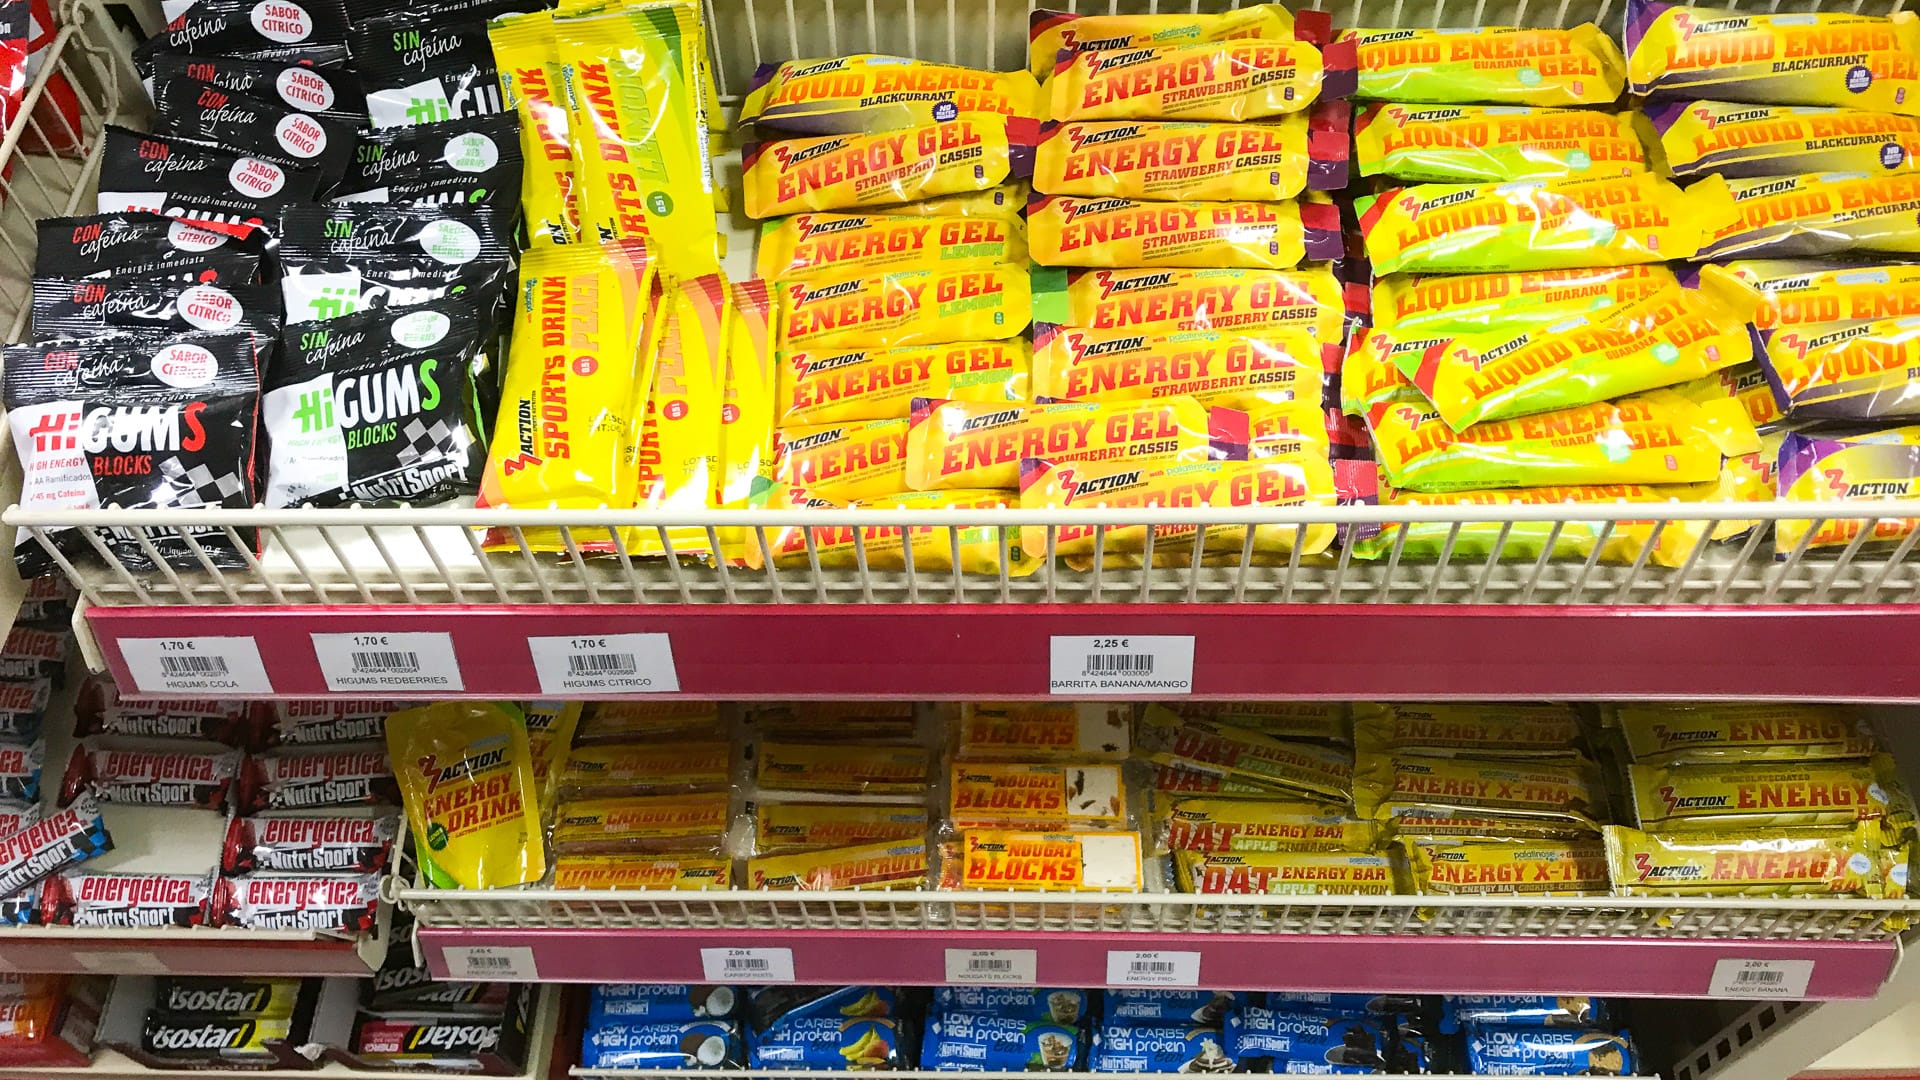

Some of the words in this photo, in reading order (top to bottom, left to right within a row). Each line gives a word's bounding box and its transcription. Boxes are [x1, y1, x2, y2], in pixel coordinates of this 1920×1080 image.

[265, 4, 300, 20] SABOR
[261, 18, 304, 35] CITRICO
[393, 30, 420, 52] SIN
[1449, 32, 1573, 63] ENERGY
[1473, 58, 1531, 71] GUARANA
[1665, 35, 1776, 72] LIQUID
[1771, 54, 1869, 74] BLACKCURRANT
[187, 63, 216, 82] CON
[1538, 55, 1598, 78] GEL
[291, 71, 324, 92] SABOR
[1081, 53, 1217, 110] ENERGY
[1229, 46, 1297, 76] GEL
[1161, 77, 1250, 106] STRAWBERRY
[1251, 68, 1296, 86] CASSIS
[197, 89, 229, 110] CON
[285, 84, 325, 106] CITRICO
[766, 79, 866, 106] LIQUID
[859, 90, 956, 109] BLACKCURRANT
[200, 103, 257, 133] cafeína
[291, 117, 321, 142] SABOR
[1383, 121, 1489, 156] LIQUID
[1498, 116, 1621, 143] ENERGY
[1694, 120, 1804, 157] LIQUID
[138, 139, 170, 161] CON
[282, 128, 315, 155] CITRICO
[1521, 138, 1581, 151] GUARANA
[1587, 140, 1646, 164] GEL
[1804, 133, 1898, 152] BLACKCURRANT
[356, 144, 384, 164] SIN
[776, 134, 915, 204] ENERGY
[916, 121, 981, 157] GEL
[1062, 132, 1207, 183] ENERGY
[1215, 129, 1283, 159] GEL
[144, 152, 209, 183] cafeína
[246, 159, 280, 182] SABOR
[854, 154, 938, 192] STRAWBERRY
[939, 145, 983, 165] CASSIS
[1143, 159, 1234, 184] STRAWBERRY
[1235, 153, 1282, 169] CASSIS
[235, 171, 273, 193] CITRICO
[1211, 202, 1278, 226] GEL
[1611, 205, 1669, 230] GEL
[72, 222, 103, 245] CON
[176, 231, 218, 246] CITRICO
[324, 218, 353, 239] SIN
[1142, 227, 1232, 251] STRAWBERRY
[1396, 205, 1509, 251] LIQUID
[80, 225, 144, 263] cafeína
[790, 223, 931, 271] ENERGY
[938, 219, 1005, 247] GEL
[940, 242, 1005, 261] LEMON
[74, 283, 106, 304] CON
[1249, 279, 1319, 310] GEL
[1396, 275, 1510, 320] LIQUID
[1544, 285, 1609, 304] GUARANA
[541, 274, 567, 349] DRINK
[787, 282, 928, 339] ENERGY
[935, 272, 1004, 304] GEL
[938, 292, 1004, 319] LEMON
[1271, 307, 1318, 322] CASSIS
[300, 329, 329, 351] SIN
[305, 331, 366, 370] cafeína
[1604, 335, 1659, 361] GUARANA
[791, 354, 937, 411] ENERGY
[945, 346, 1014, 375] GEL
[949, 368, 1015, 390] LEMON
[1065, 348, 1218, 401] ENERGY
[1226, 342, 1297, 372] GEL
[1463, 343, 1574, 401] LIQUID
[1151, 374, 1247, 400] STRAWBERRY
[1248, 370, 1296, 386] CASSIS
[540, 353, 571, 460] SPORTS
[347, 420, 398, 451] BLOCKS
[1631, 422, 1684, 451] GEL
[1129, 440, 1179, 457] CASSIS
[92, 454, 153, 477] BLOCKS
[1229, 470, 1306, 507] GEL
[160, 640, 185, 652] 1,70
[187, 640, 196, 651] €
[353, 636, 380, 647] 1,70
[380, 636, 389, 646] €
[570, 639, 596, 650] 1,70
[598, 638, 607, 649] €
[1093, 639, 1119, 649] 2,25
[1121, 639, 1129, 649] €
[166, 680, 209, 689] HIGUMS
[209, 679, 240, 689] COLA
[336, 676, 379, 686] HIGUMS
[380, 675, 449, 686] REDBERRIES
[563, 679, 607, 689] HIGUMS
[607, 677, 652, 687] CITRICO
[1051, 680, 1098, 689] BARRITA
[1100, 680, 1189, 689] BANANA/MANGO
[993, 774, 1060, 789] NOUGAT
[1393, 775, 1490, 798] ENERGY
[1497, 783, 1571, 804] X-TRA
[423, 771, 514, 821] ENERGY
[953, 789, 1061, 810] BLOCKS
[1737, 782, 1869, 810] ENERGY
[447, 790, 523, 834] DRINK
[1244, 823, 1312, 839] ENERGY
[1313, 824, 1345, 839] BAR
[1007, 842, 1075, 859] NOUGAT
[1234, 838, 1278, 851] APPLE
[966, 859, 1077, 881] BLOCKS
[1281, 866, 1351, 882] ENERGY
[1352, 866, 1387, 881] BAR
[1431, 862, 1526, 884] ENERGY
[1710, 851, 1851, 882] ENERGY
[1272, 883, 1316, 895] APPLE
[1315, 883, 1389, 896] CINNAMON
[1461, 883, 1499, 893] ENERGY
[1499, 884, 1516, 893] BAR
[168, 984, 256, 1012] isostar
[986, 992, 1036, 1009] protein
[794, 1018, 844, 1029] CARBS
[943, 1012, 975, 1026] LOW
[976, 1016, 1027, 1031] CARBS
[1243, 1006, 1274, 1019] LOW
[152, 1024, 239, 1049] isostar
[792, 1029, 842, 1045] protein
[943, 1025, 974, 1039] HIGH
[975, 1027, 1026, 1044] protein
[1102, 1026, 1133, 1038] LOW
[1135, 1027, 1186, 1039] CARBS
[1243, 1017, 1275, 1031] HIGH
[1277, 1021, 1329, 1037] protein
[629, 1033, 678, 1048] protein
[1103, 1038, 1133, 1051] HIGH
[1135, 1039, 1186, 1056] protein
[1485, 1032, 1518, 1045] LOW
[1520, 1033, 1575, 1045] CARBS
[1485, 1044, 1521, 1058] HIGH
